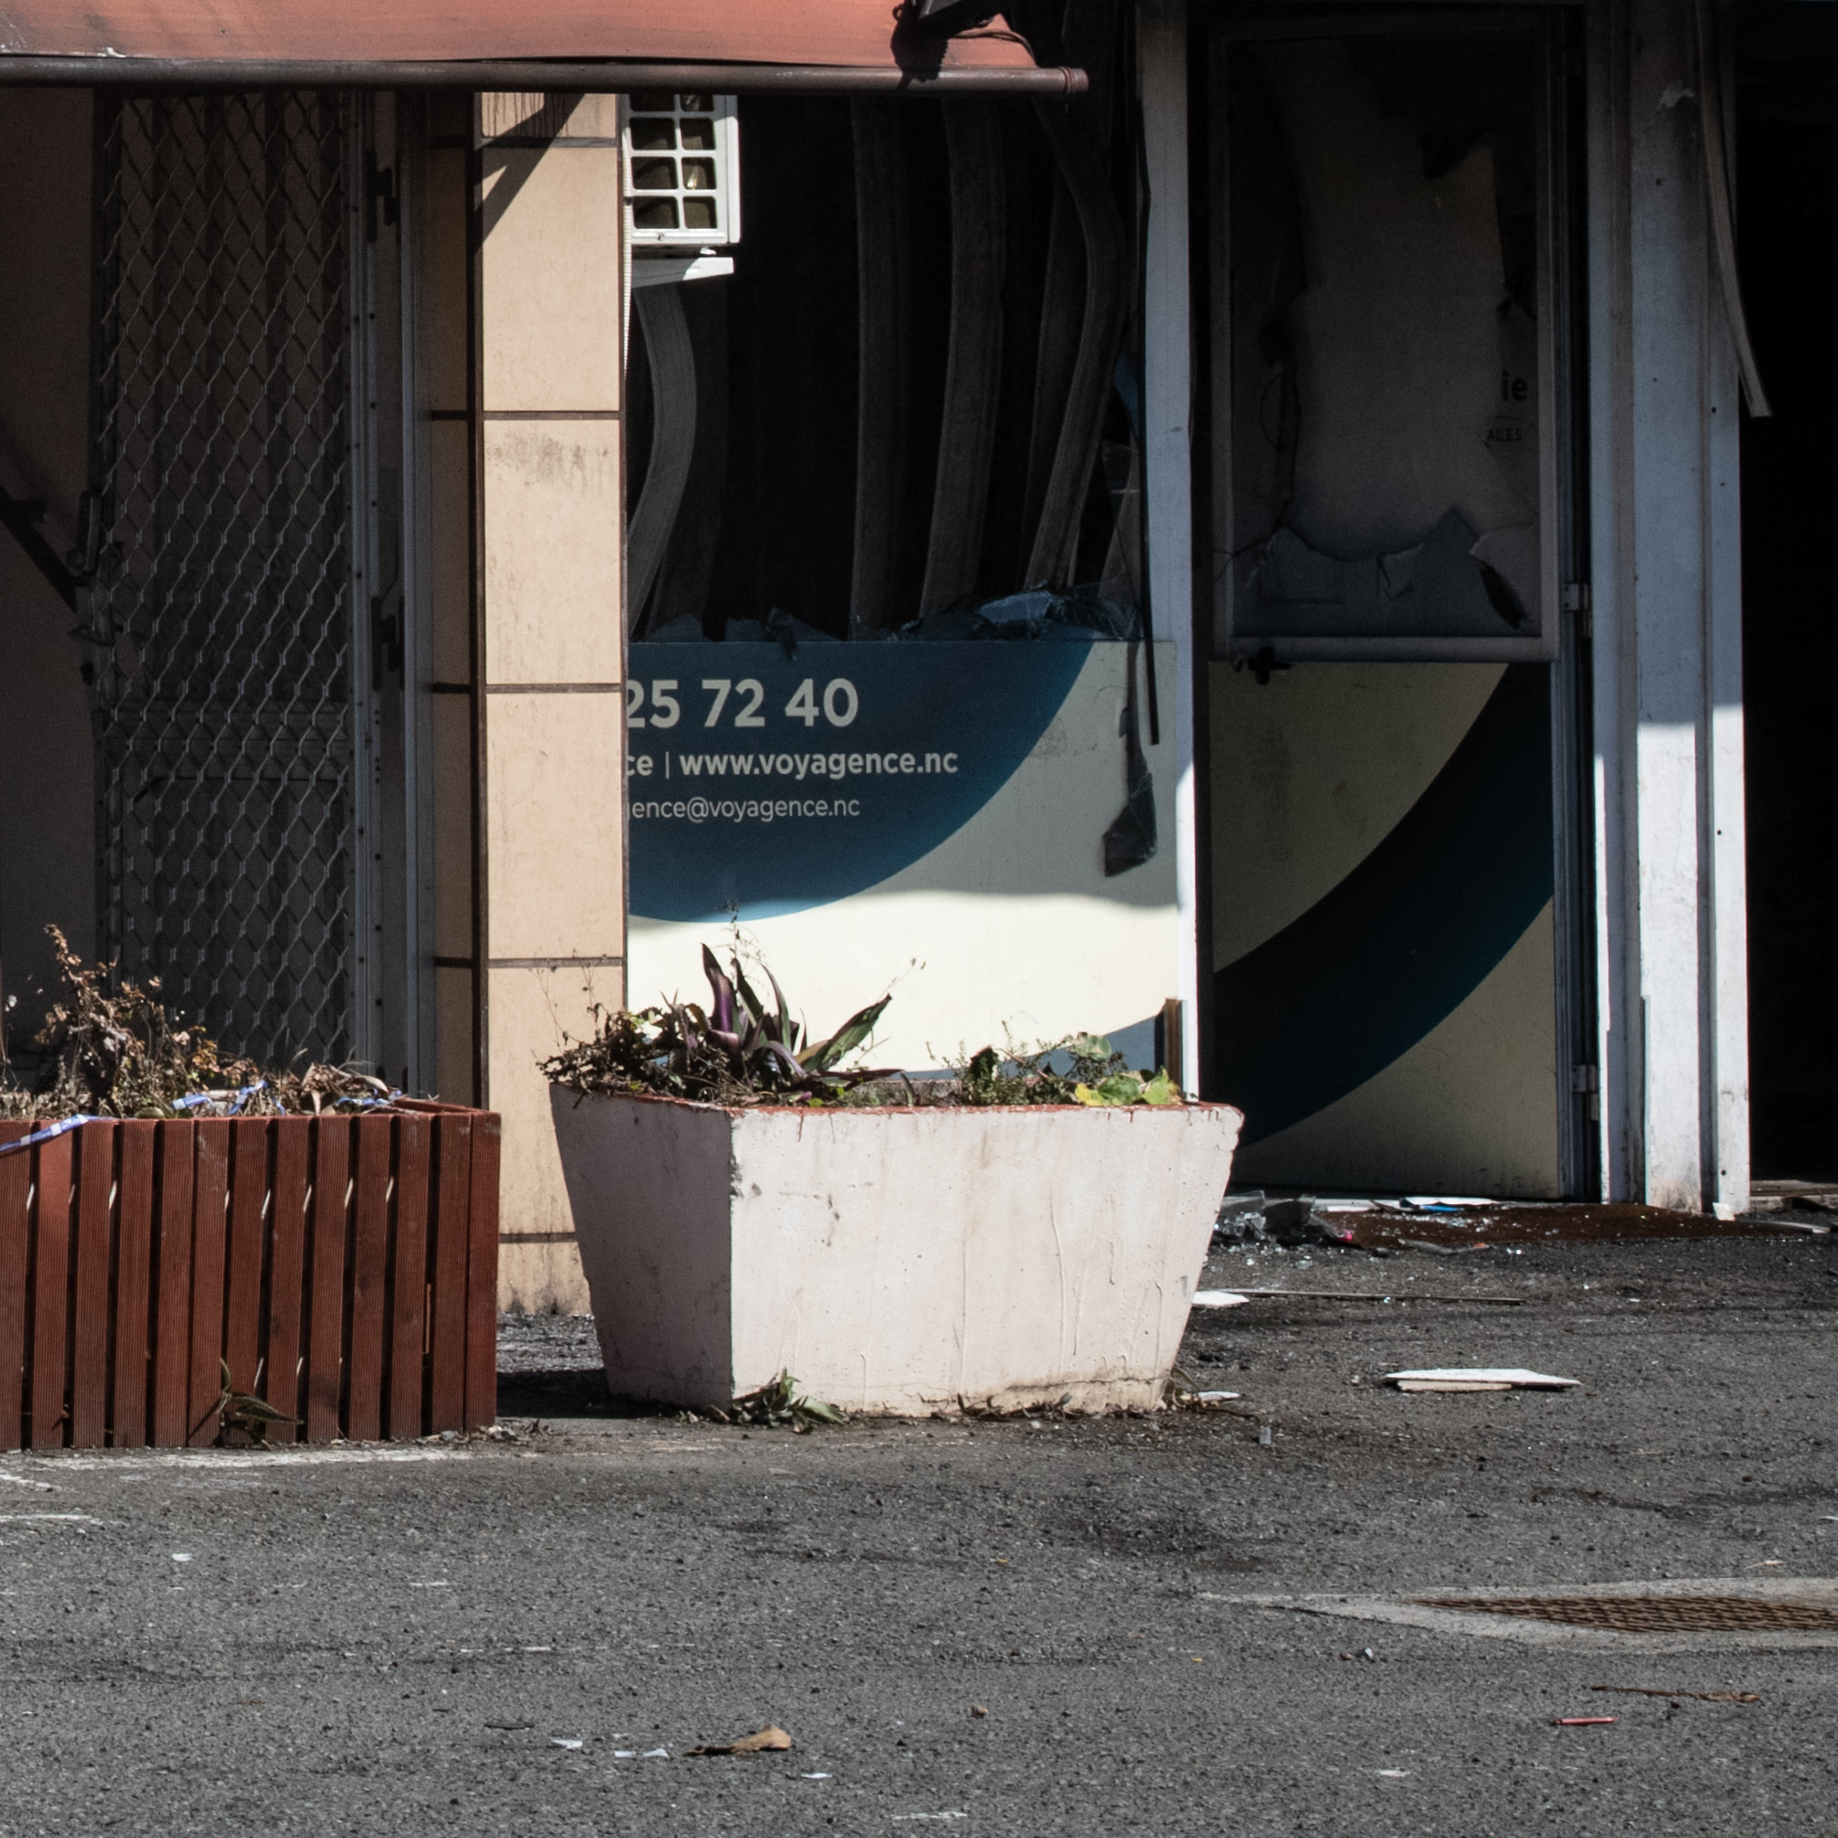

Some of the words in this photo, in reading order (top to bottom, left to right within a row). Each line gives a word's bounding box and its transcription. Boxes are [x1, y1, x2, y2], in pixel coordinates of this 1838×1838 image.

[625, 679, 681, 728] 25
[702, 679, 765, 728] 72
[785, 677, 858, 728] 40
[679, 752, 958, 780] www.voyagence.nc
[627, 796, 860, 824] ence@voyagence.nc
